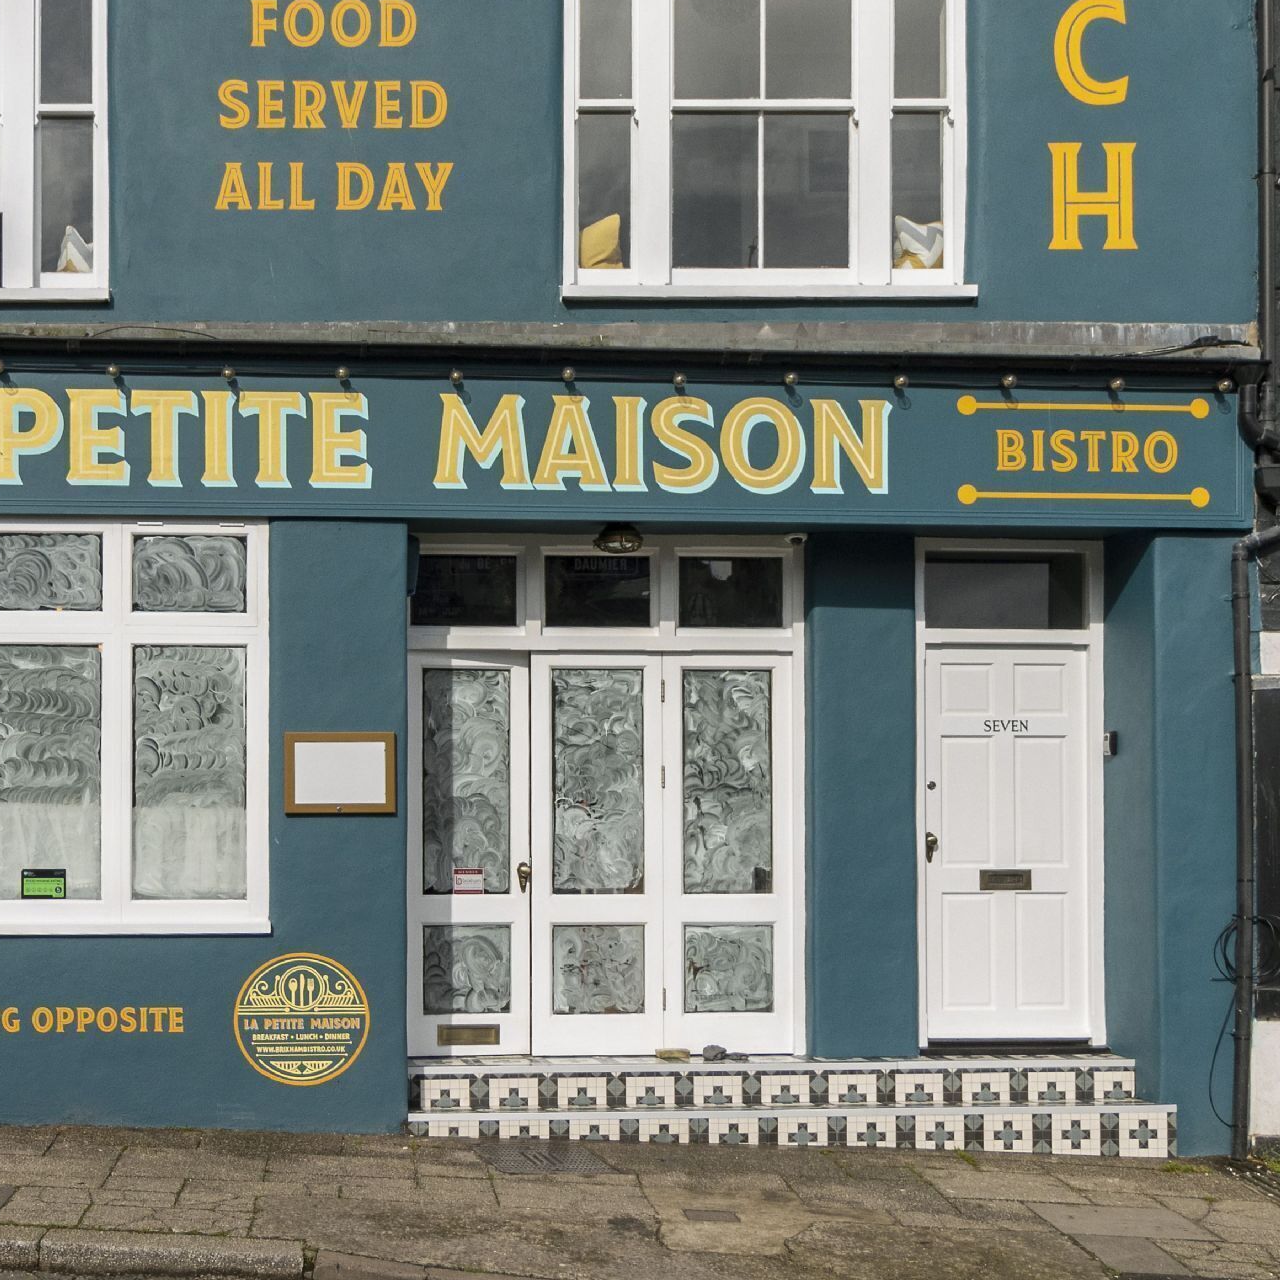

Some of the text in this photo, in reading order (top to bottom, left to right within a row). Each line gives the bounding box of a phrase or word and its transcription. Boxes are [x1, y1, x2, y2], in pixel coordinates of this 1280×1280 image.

[217, 79, 448, 130] SERVED
[215, 161, 454, 212] ALL DAY
[432, 393, 893, 495] MAISON
[995, 428, 1180, 475] BISTRO
[983, 719, 1029, 733] SEVEN
[31, 1006, 185, 1034] OPPOSITE
[243, 1017, 361, 1031] LA PETITE MAISON
[252, 1033, 289, 1041] BREAKFAST
[295, 1033, 319, 1041] LUNCH
